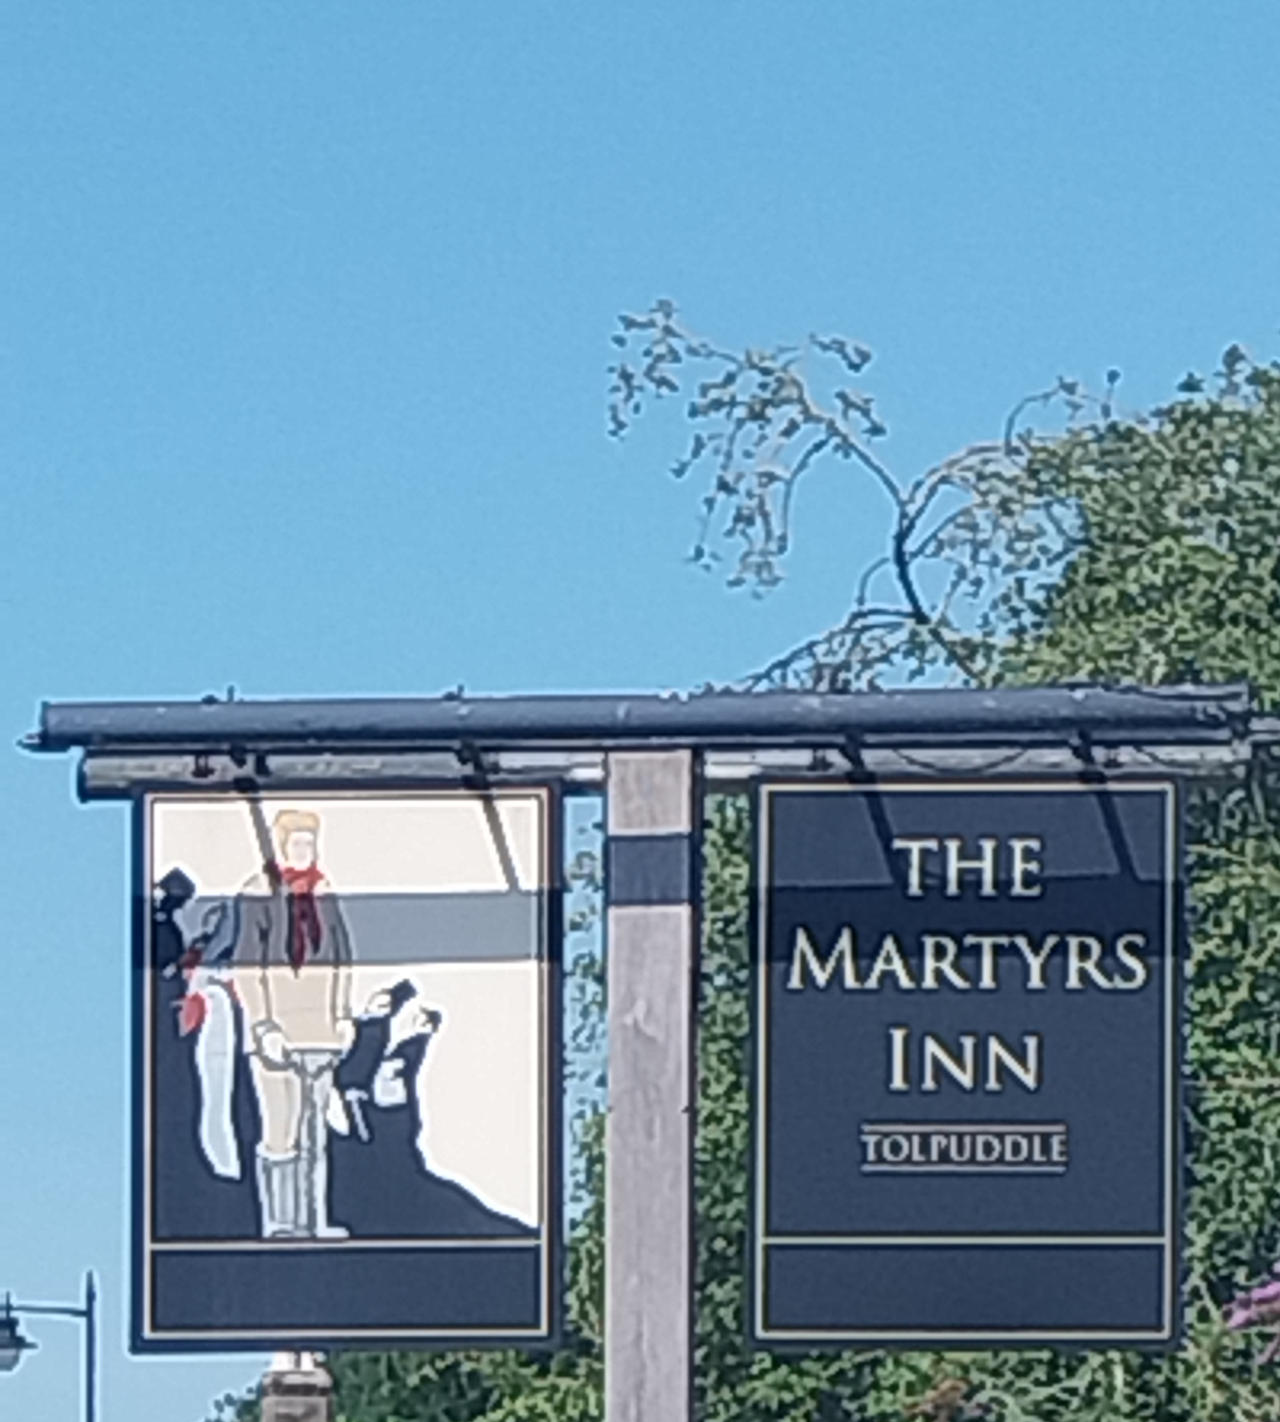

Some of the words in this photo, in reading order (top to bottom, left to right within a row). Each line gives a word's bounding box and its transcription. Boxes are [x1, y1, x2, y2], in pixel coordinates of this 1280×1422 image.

[891, 838, 1042, 896] THE
[787, 926, 1148, 990] MARTYRS
[888, 1028, 1040, 1091] INN
[860, 1134, 1067, 1162] TOLPUDDLE
